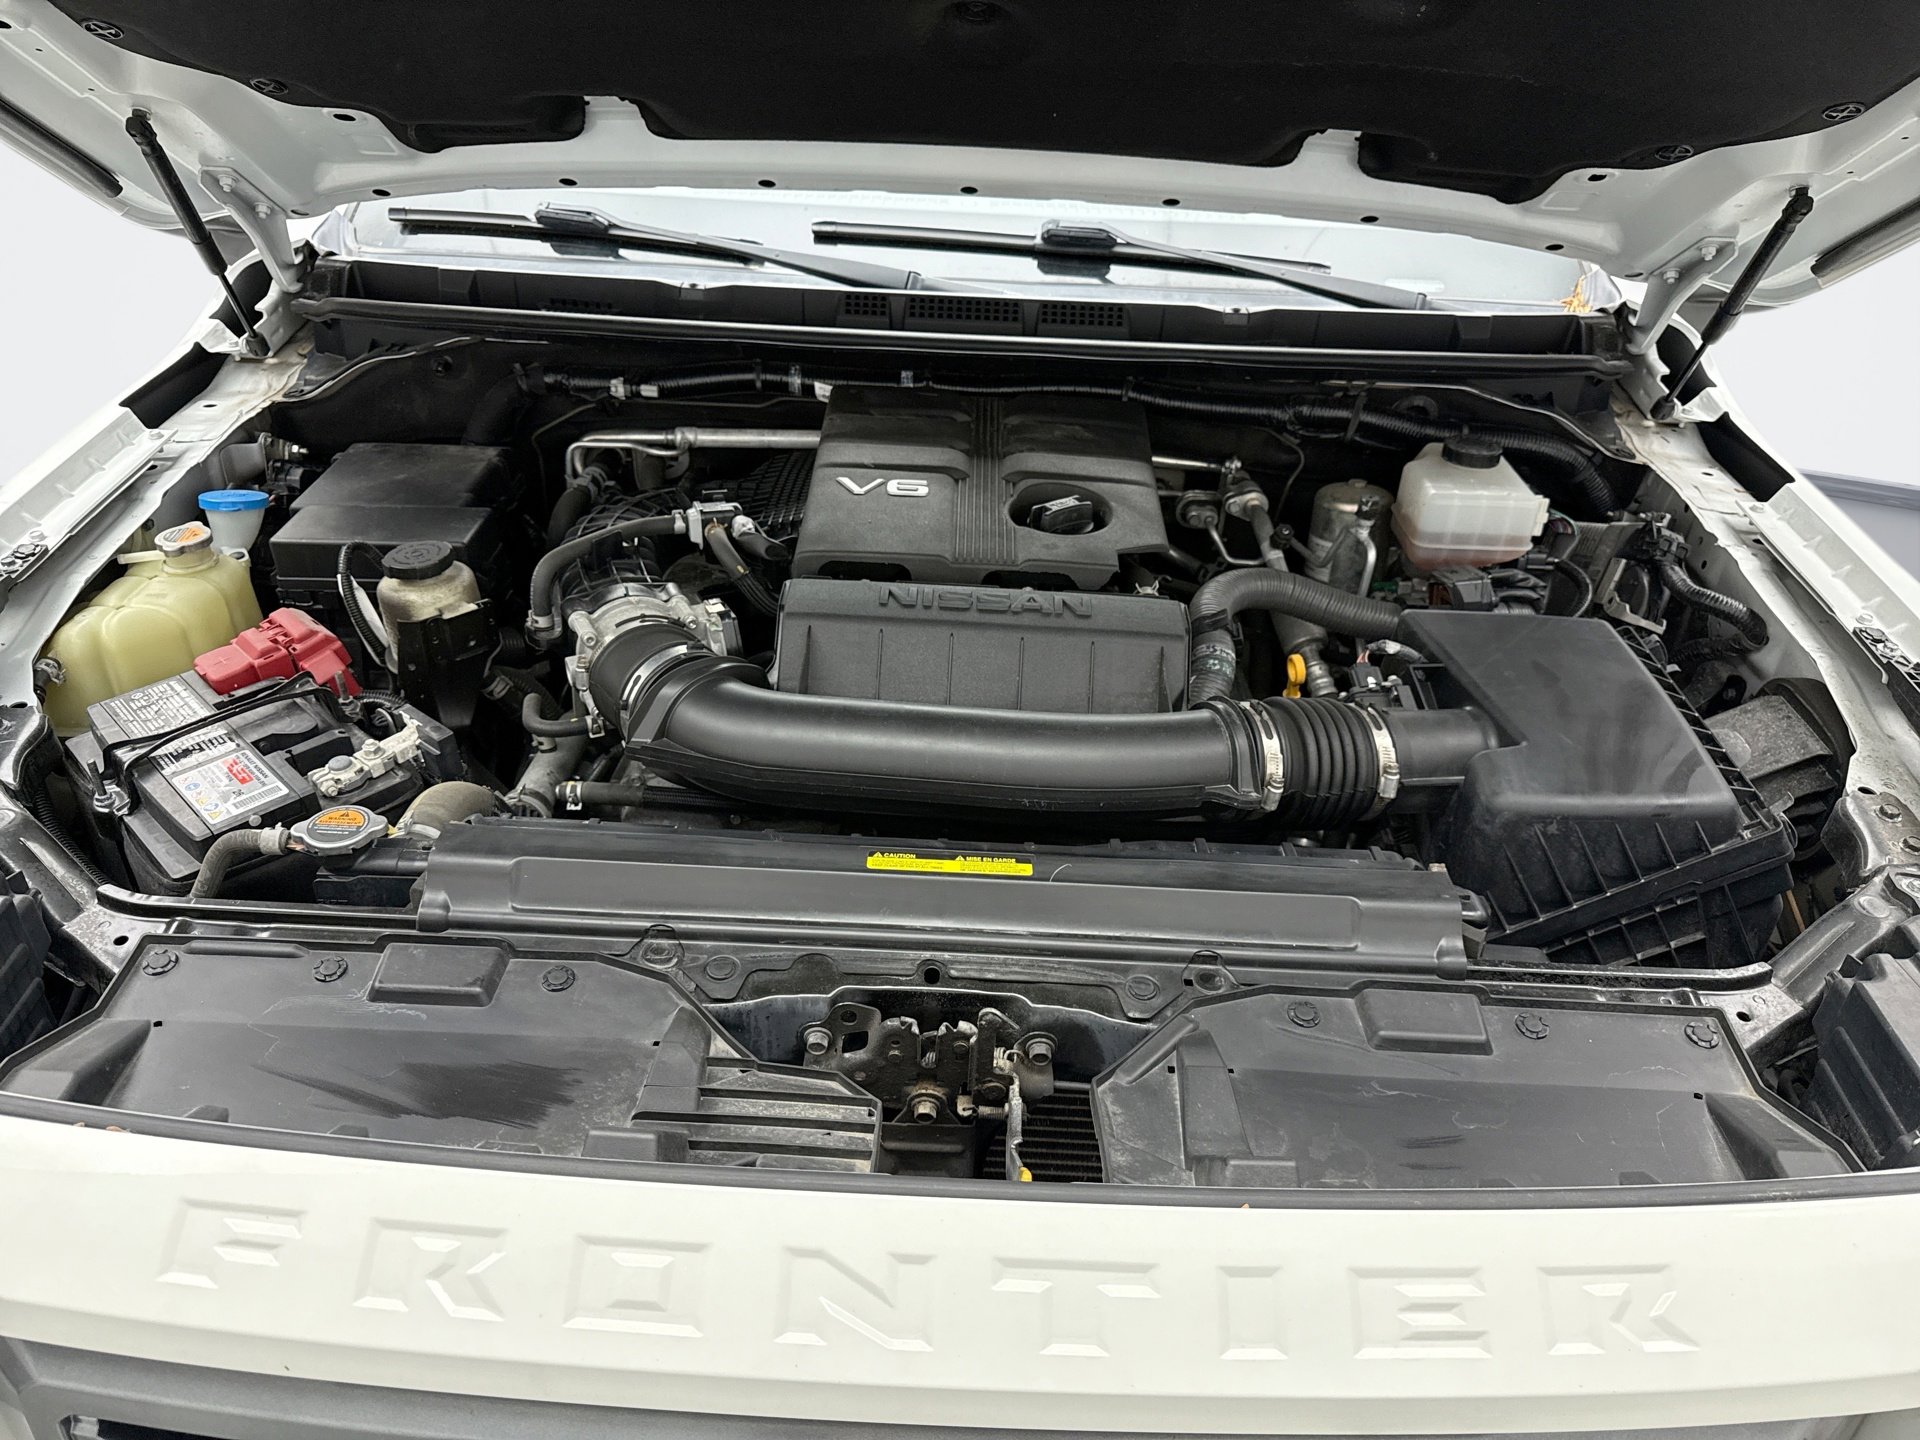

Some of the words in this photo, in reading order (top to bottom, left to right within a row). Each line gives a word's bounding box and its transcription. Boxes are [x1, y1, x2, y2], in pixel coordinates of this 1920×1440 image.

[836, 476, 929, 497] V6
[879, 585, 1093, 617] NISSAN
[254, 764, 269, 779] NISSAN
[154, 1197, 1702, 1361] FRONTIER
